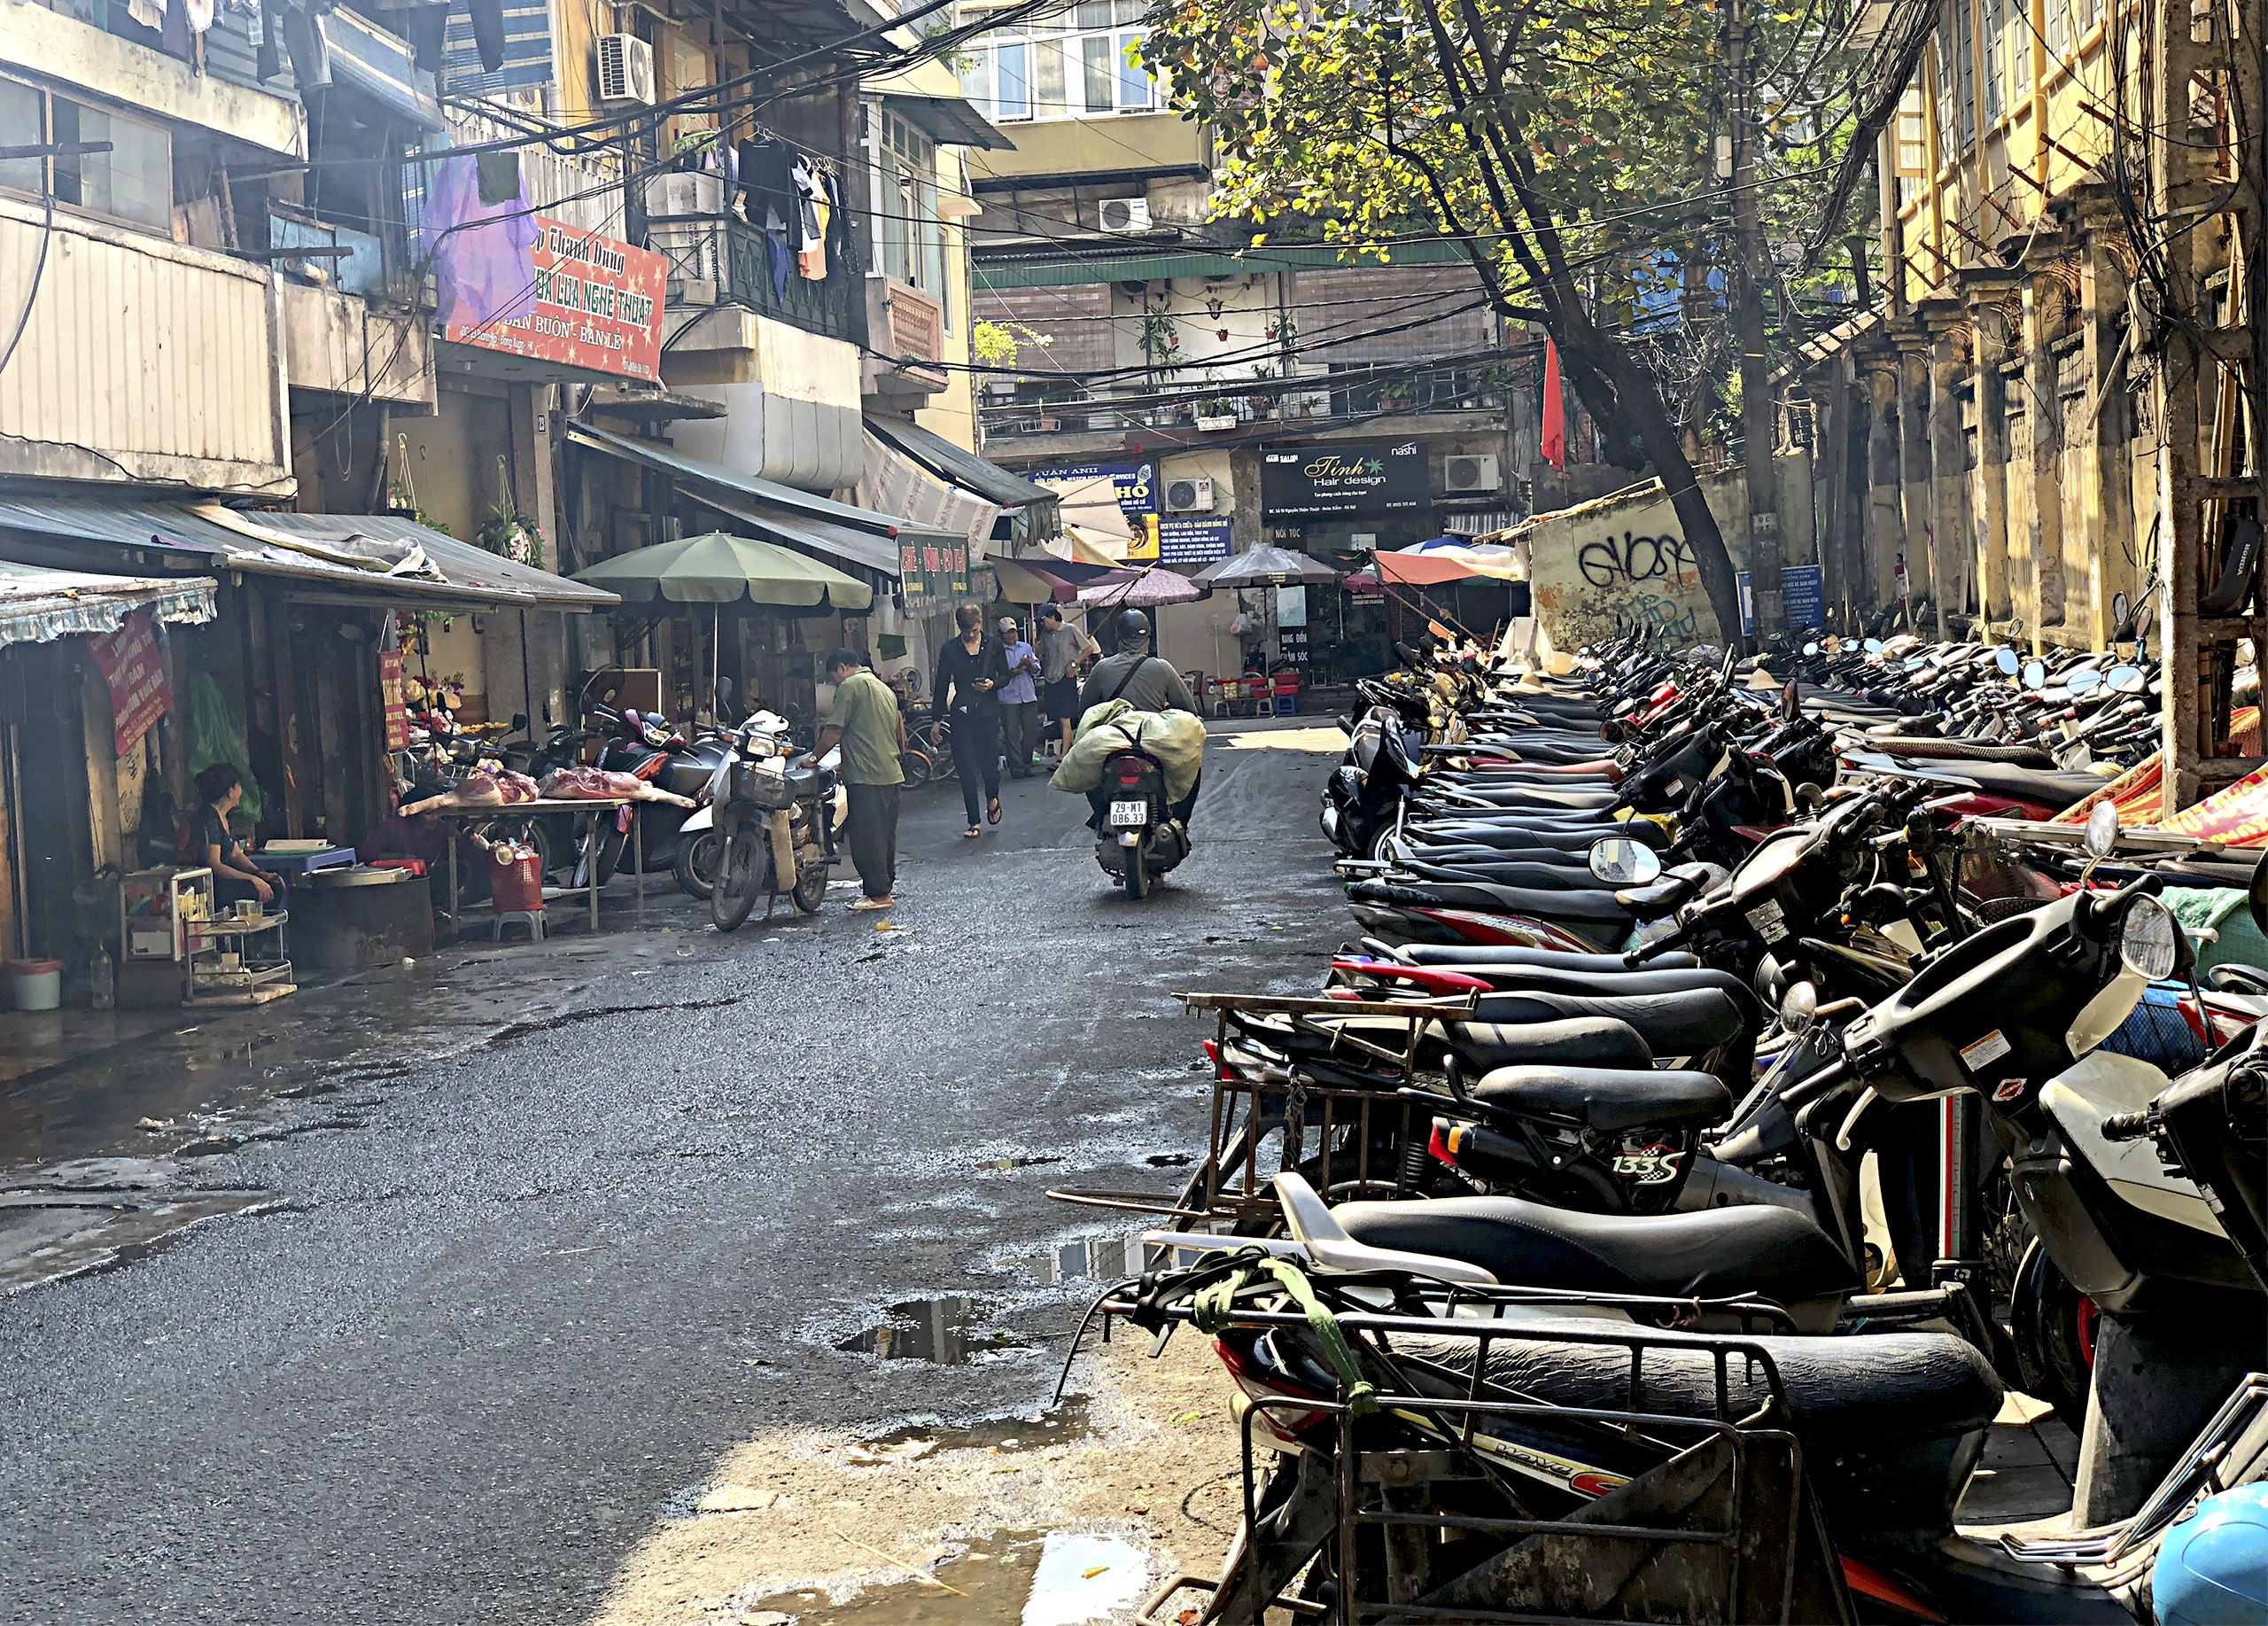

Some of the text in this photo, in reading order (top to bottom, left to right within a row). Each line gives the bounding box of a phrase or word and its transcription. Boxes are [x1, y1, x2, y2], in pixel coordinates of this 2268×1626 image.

[535, 315, 571, 339] BUÔN
[579, 323, 604, 348] BÁN
[1391, 442, 1417, 455] nashi
[1314, 475, 1386, 486] Hair design
[2237, 543, 2250, 576] HONDA
[1115, 803, 1141, 813] 29-M1
[1112, 813, 1144, 823] 086.33
